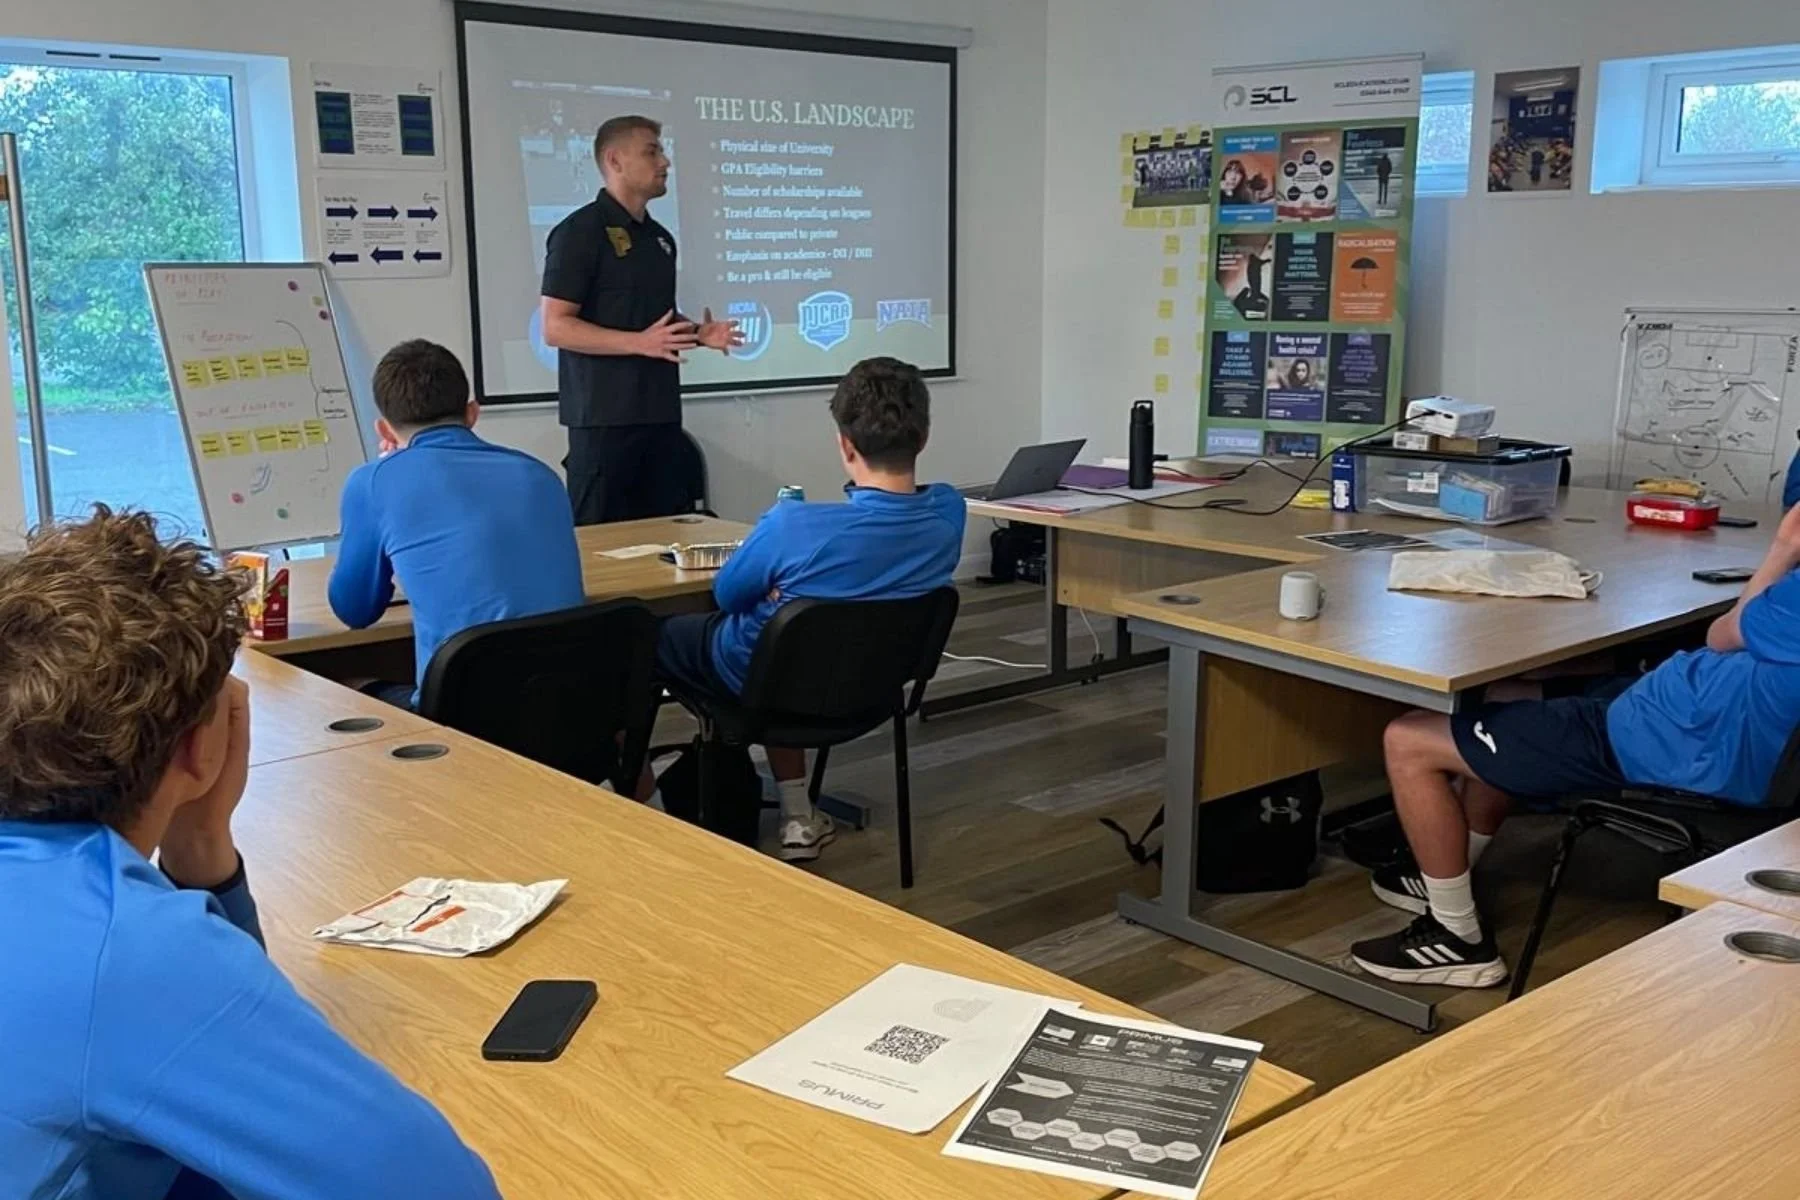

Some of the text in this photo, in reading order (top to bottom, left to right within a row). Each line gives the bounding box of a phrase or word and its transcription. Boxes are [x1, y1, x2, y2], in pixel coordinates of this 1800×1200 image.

[1250, 85, 1297, 105] SCL
[695, 96, 915, 130] THE U.S. LANDSCAPE
[720, 139, 834, 157] Physical size of University
[720, 162, 823, 178] GPA Eligibility barriers
[723, 186, 863, 199] Number of scholarships available
[723, 207, 752, 219] Travel
[783, 207, 828, 221] depending
[829, 209, 840, 218] on
[725, 228, 838, 242] Public compared to private
[726, 250, 769, 263] Emphasis
[770, 251, 782, 260] on
[783, 248, 826, 260] academics
[747, 273, 762, 284] pro
[773, 269, 790, 281] still
[791, 269, 801, 280] be
[803, 267, 832, 281] eligible
[1787, 335, 1797, 373] FORZA
[798, 1079, 885, 1111] PRIMUS
